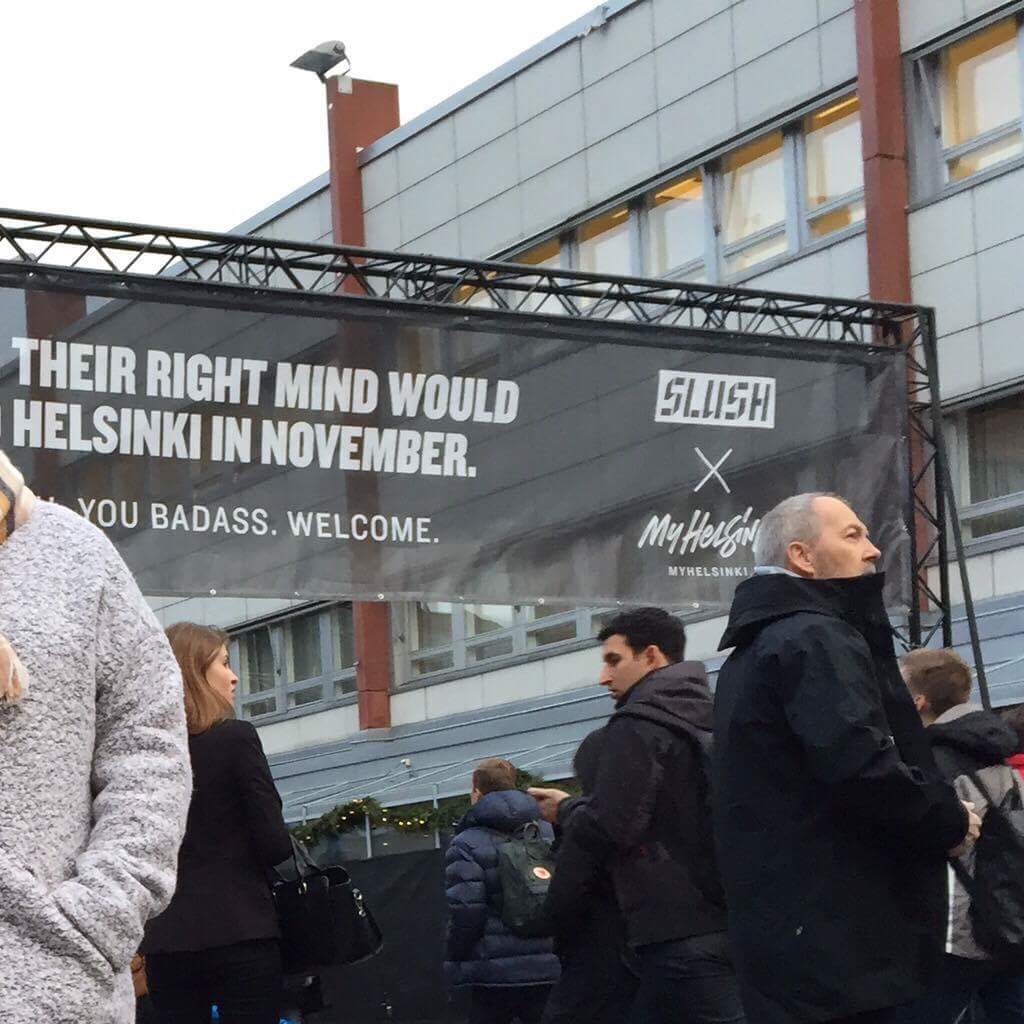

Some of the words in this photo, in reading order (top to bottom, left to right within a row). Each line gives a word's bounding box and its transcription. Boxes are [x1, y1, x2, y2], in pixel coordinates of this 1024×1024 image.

[12, 337, 136, 395] THEIR
[146, 350, 268, 405] RIGHT
[275, 362, 378, 415] MIND
[388, 371, 520, 424] WOULD
[660, 377, 771, 422] SLUSH
[13, 398, 202, 460] HELSINKI
[210, 416, 252, 463] IN
[261, 420, 476, 478] NOVEMBER.
[77, 497, 138, 529] YOU
[151, 503, 276, 536] BADASS.
[287, 511, 439, 543] WELCOME.
[668, 566, 748, 577] MYHELSINKI
